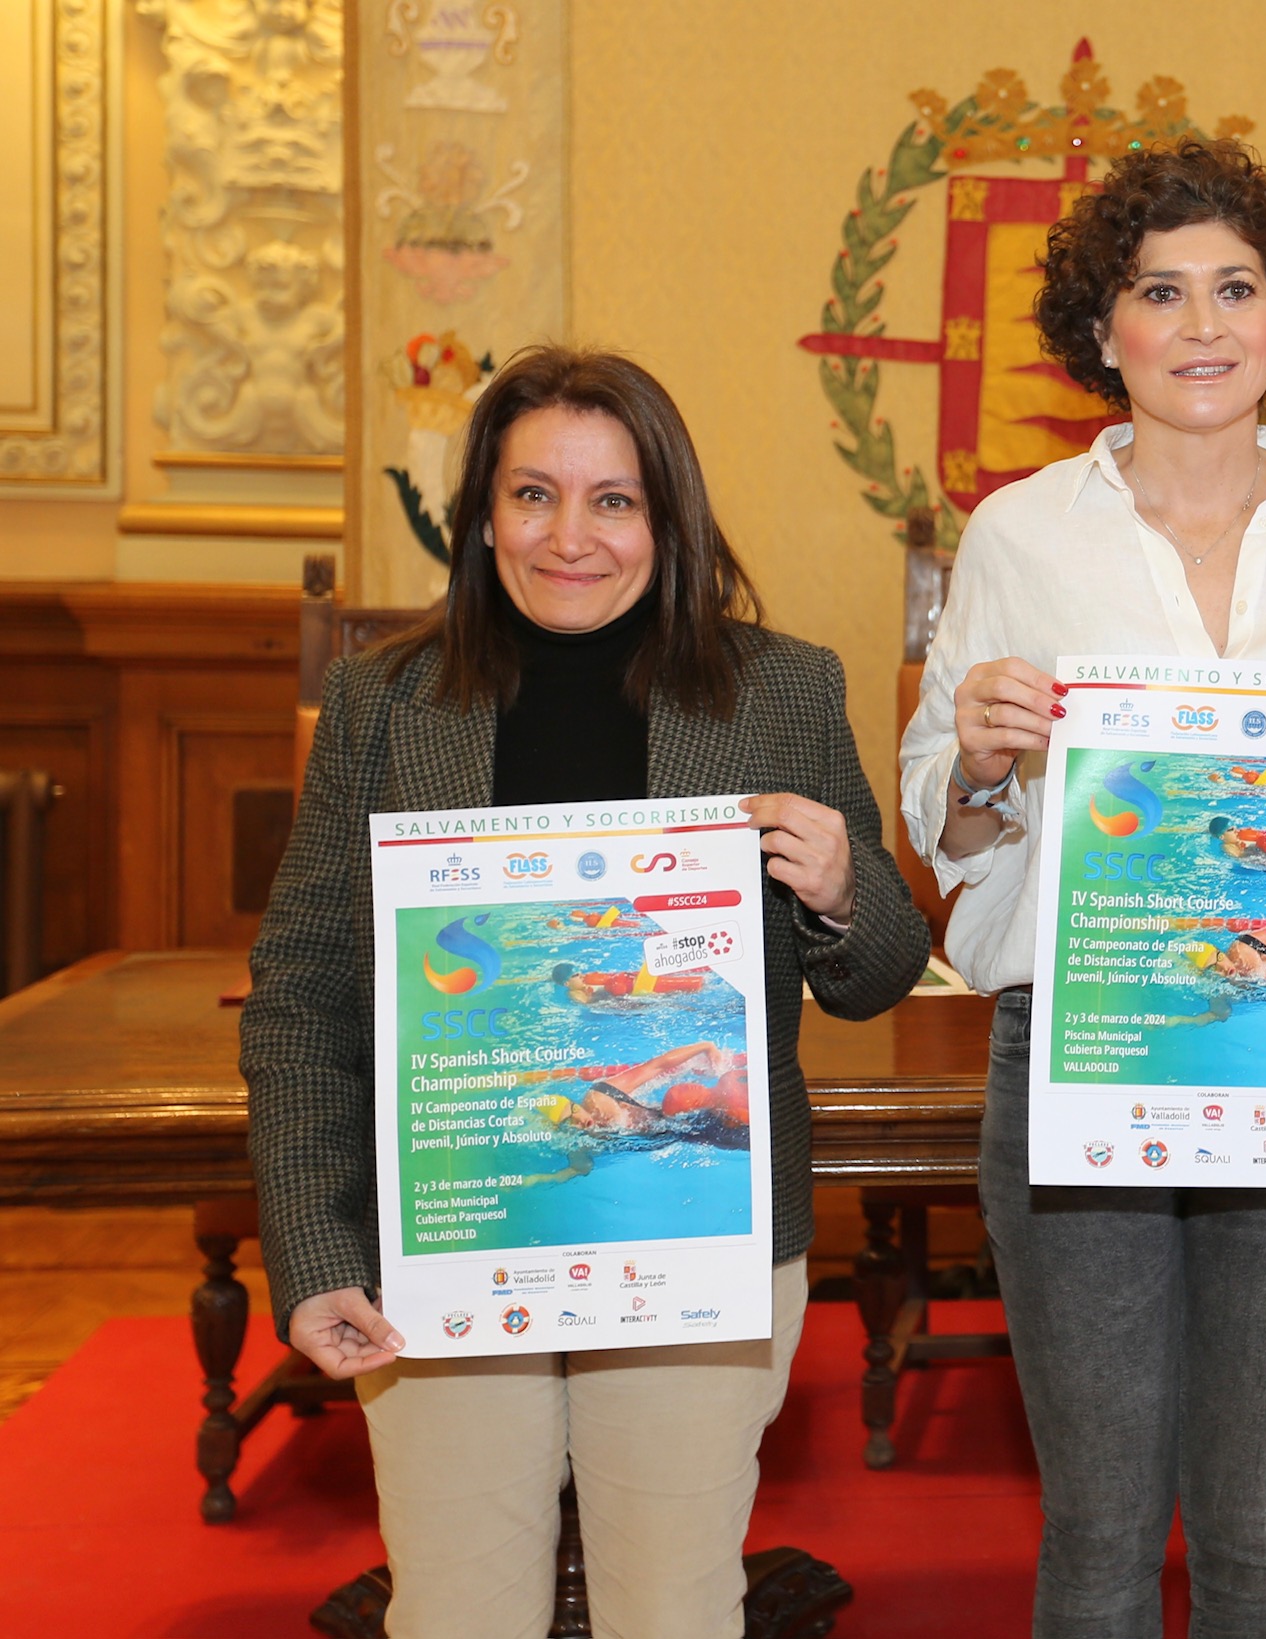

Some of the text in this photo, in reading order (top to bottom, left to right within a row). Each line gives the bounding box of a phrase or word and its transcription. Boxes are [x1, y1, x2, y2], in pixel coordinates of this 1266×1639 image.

[1076, 666, 1220, 684] SALVAMENTO
[1233, 672, 1242, 685] Y
[395, 805, 736, 836] SALVAMENTO Y SOCORRISMO
[1083, 852, 1165, 881] SSCC
[667, 894, 707, 906] #SSCC24
[1072, 890, 1234, 911] IV Spanish Short Course
[1071, 912, 1170, 934] Championship
[1068, 937, 1205, 956] IV Campeonato de España
[654, 946, 709, 969] ahogados
[1067, 953, 1173, 969] de Distancias Cortas
[1065, 970, 1197, 987] Juvenil, Júnior y Absoluto
[421, 1008, 508, 1041] SSCC
[1065, 1012, 1166, 1025] 2 y 3 de marzo de 2024
[1064, 1029, 1142, 1044] Piscina Municipal
[411, 1043, 586, 1073] IV Spanish Short Course
[1064, 1043, 1148, 1058] Cubierta Parquesol
[1063, 1061, 1119, 1073] VALLADOLID
[411, 1069, 517, 1094] Championship
[411, 1093, 557, 1115] IV Campeonato de España
[411, 1112, 525, 1132] de Distancias Cortas
[1150, 1111, 1190, 1120] Valladolid
[410, 1128, 553, 1152] Juvenil, Júnior y Absoluto
[1194, 1154, 1230, 1164] SQUALI
[414, 1175, 523, 1194] 2 y 3 de marzo de 2024
[415, 1193, 498, 1210] Piscina Municipal
[415, 1208, 506, 1225] Cubierta Parquesol
[416, 1228, 476, 1243] VALLADOLID
[512, 1273, 556, 1284] Valladolid
[618, 1281, 643, 1289] Castilla
[556, 1315, 597, 1328] SQUALI
[679, 1308, 721, 1320] Safely
